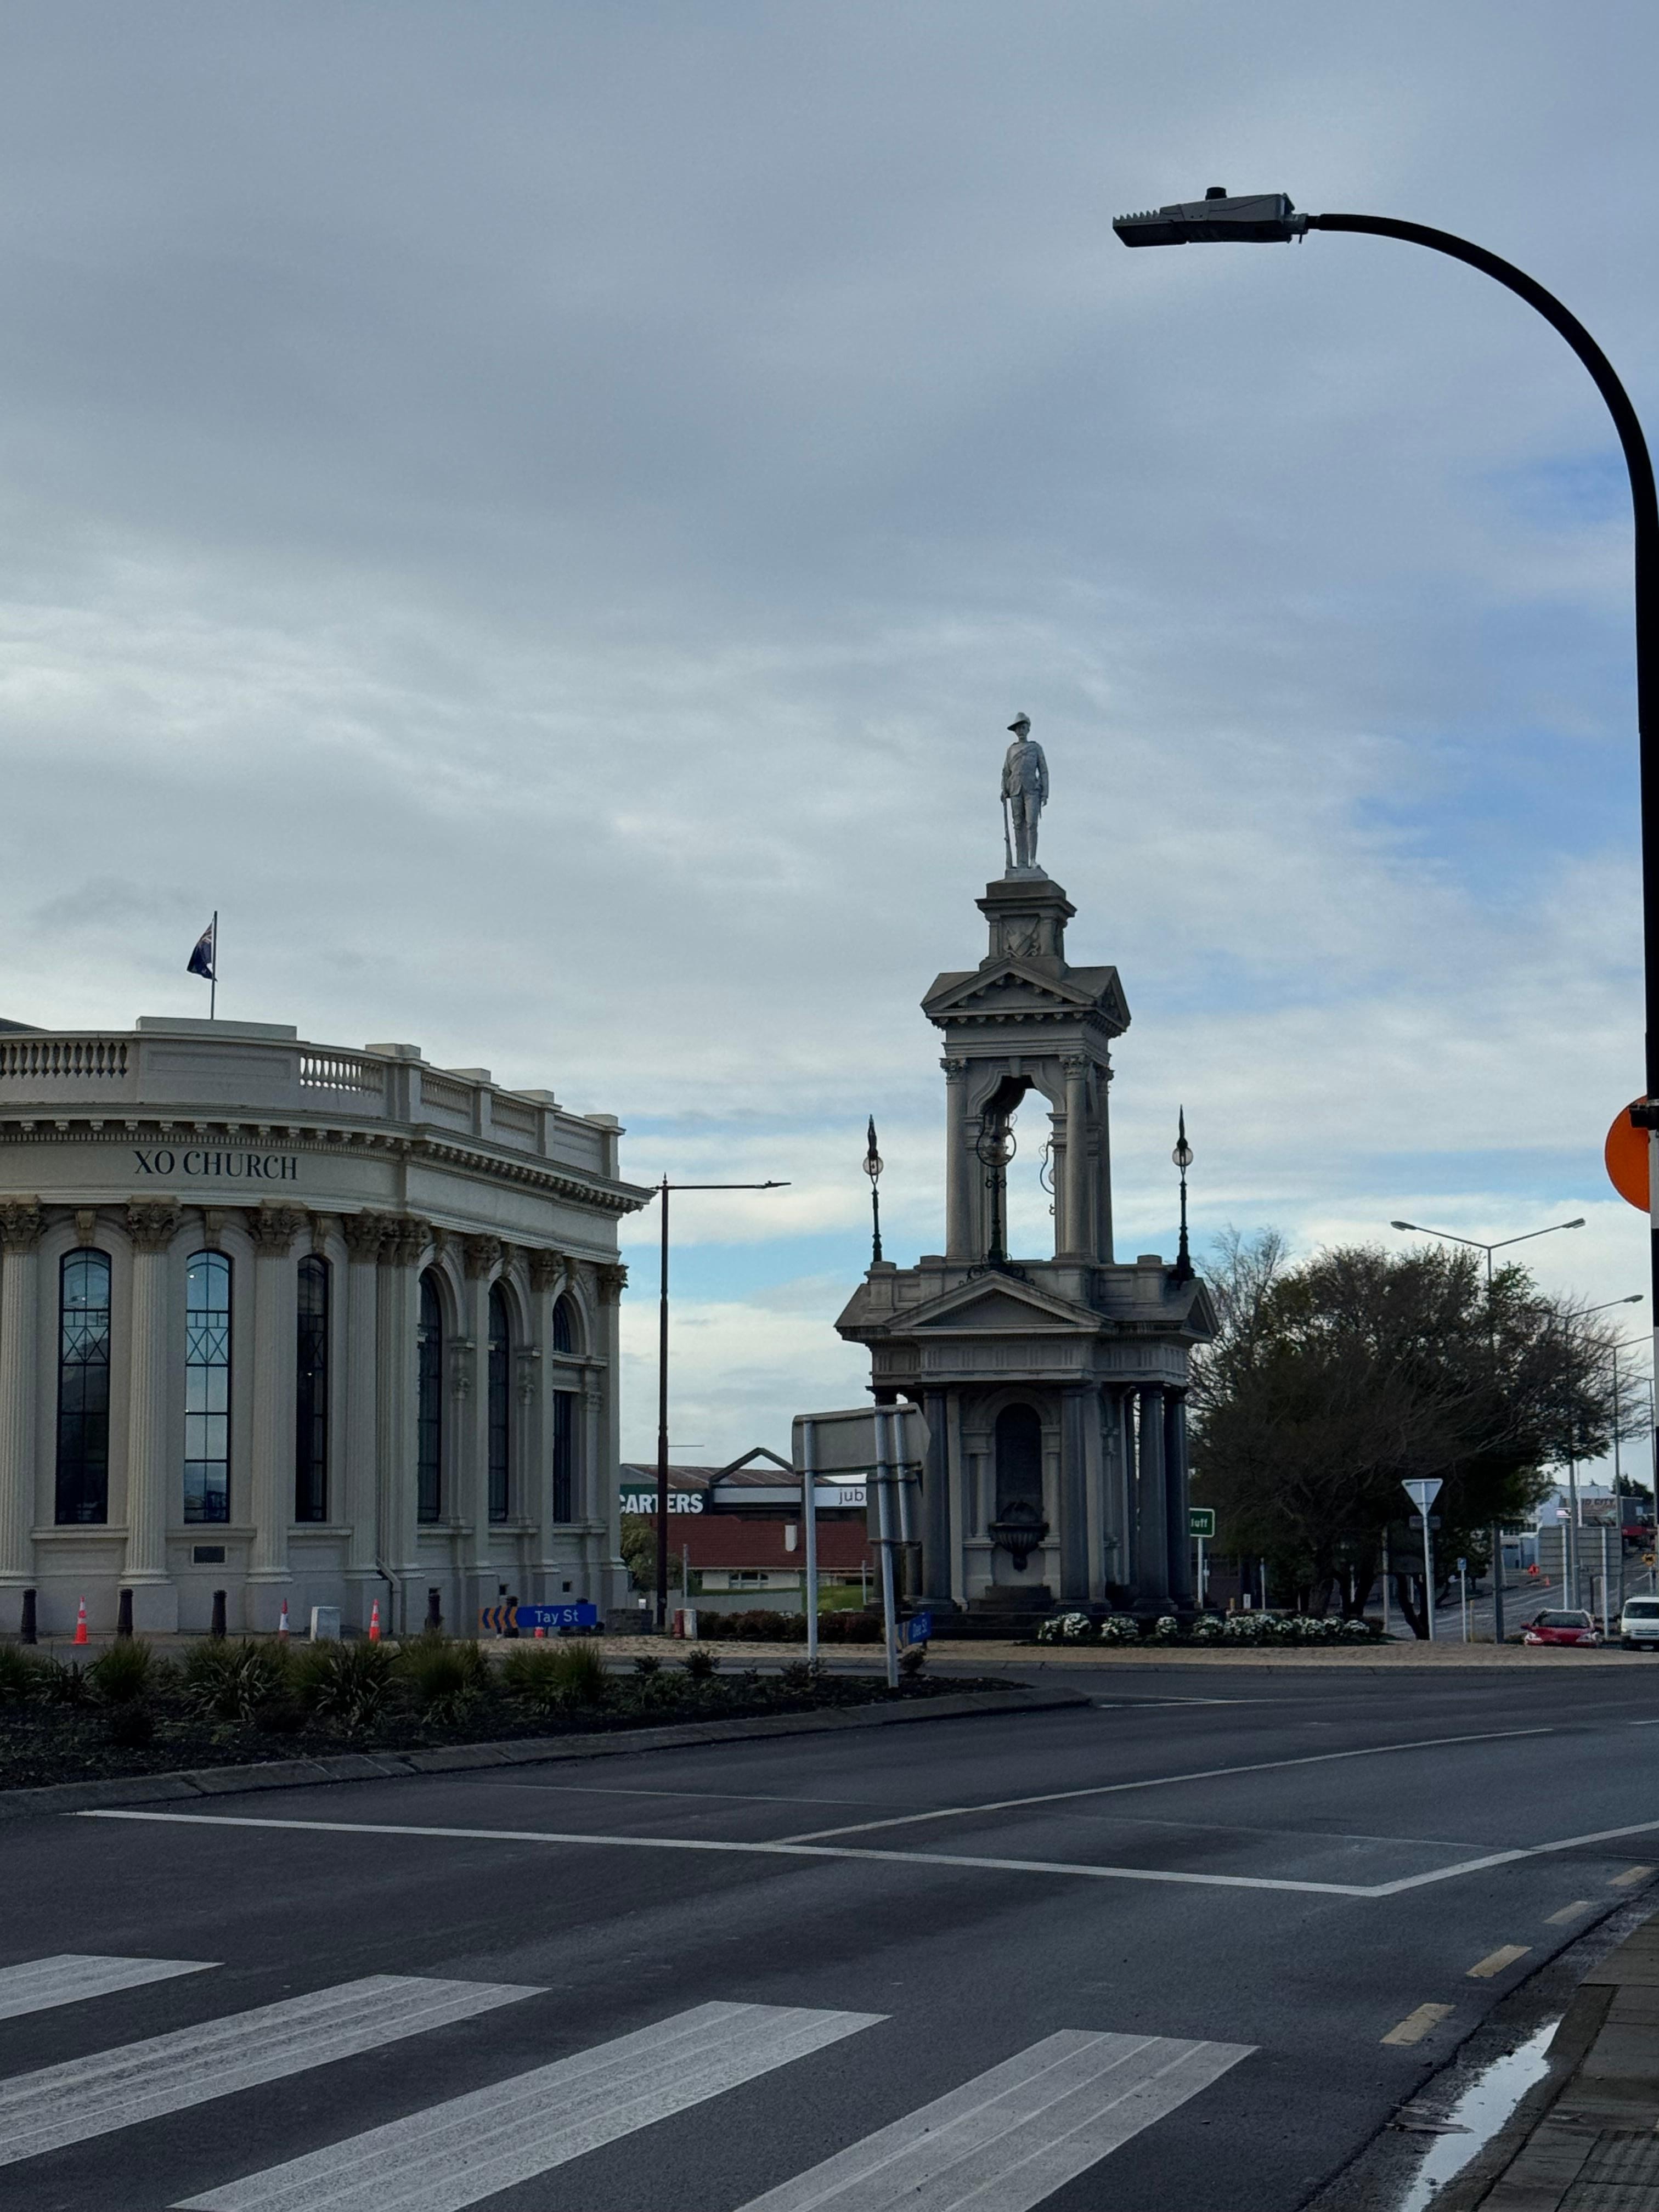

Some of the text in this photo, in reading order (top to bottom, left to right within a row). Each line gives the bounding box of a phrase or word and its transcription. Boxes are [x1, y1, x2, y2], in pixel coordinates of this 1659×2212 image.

[133, 1150, 298, 1180] XO CHURCH
[535, 1609, 579, 1624] Tay St
